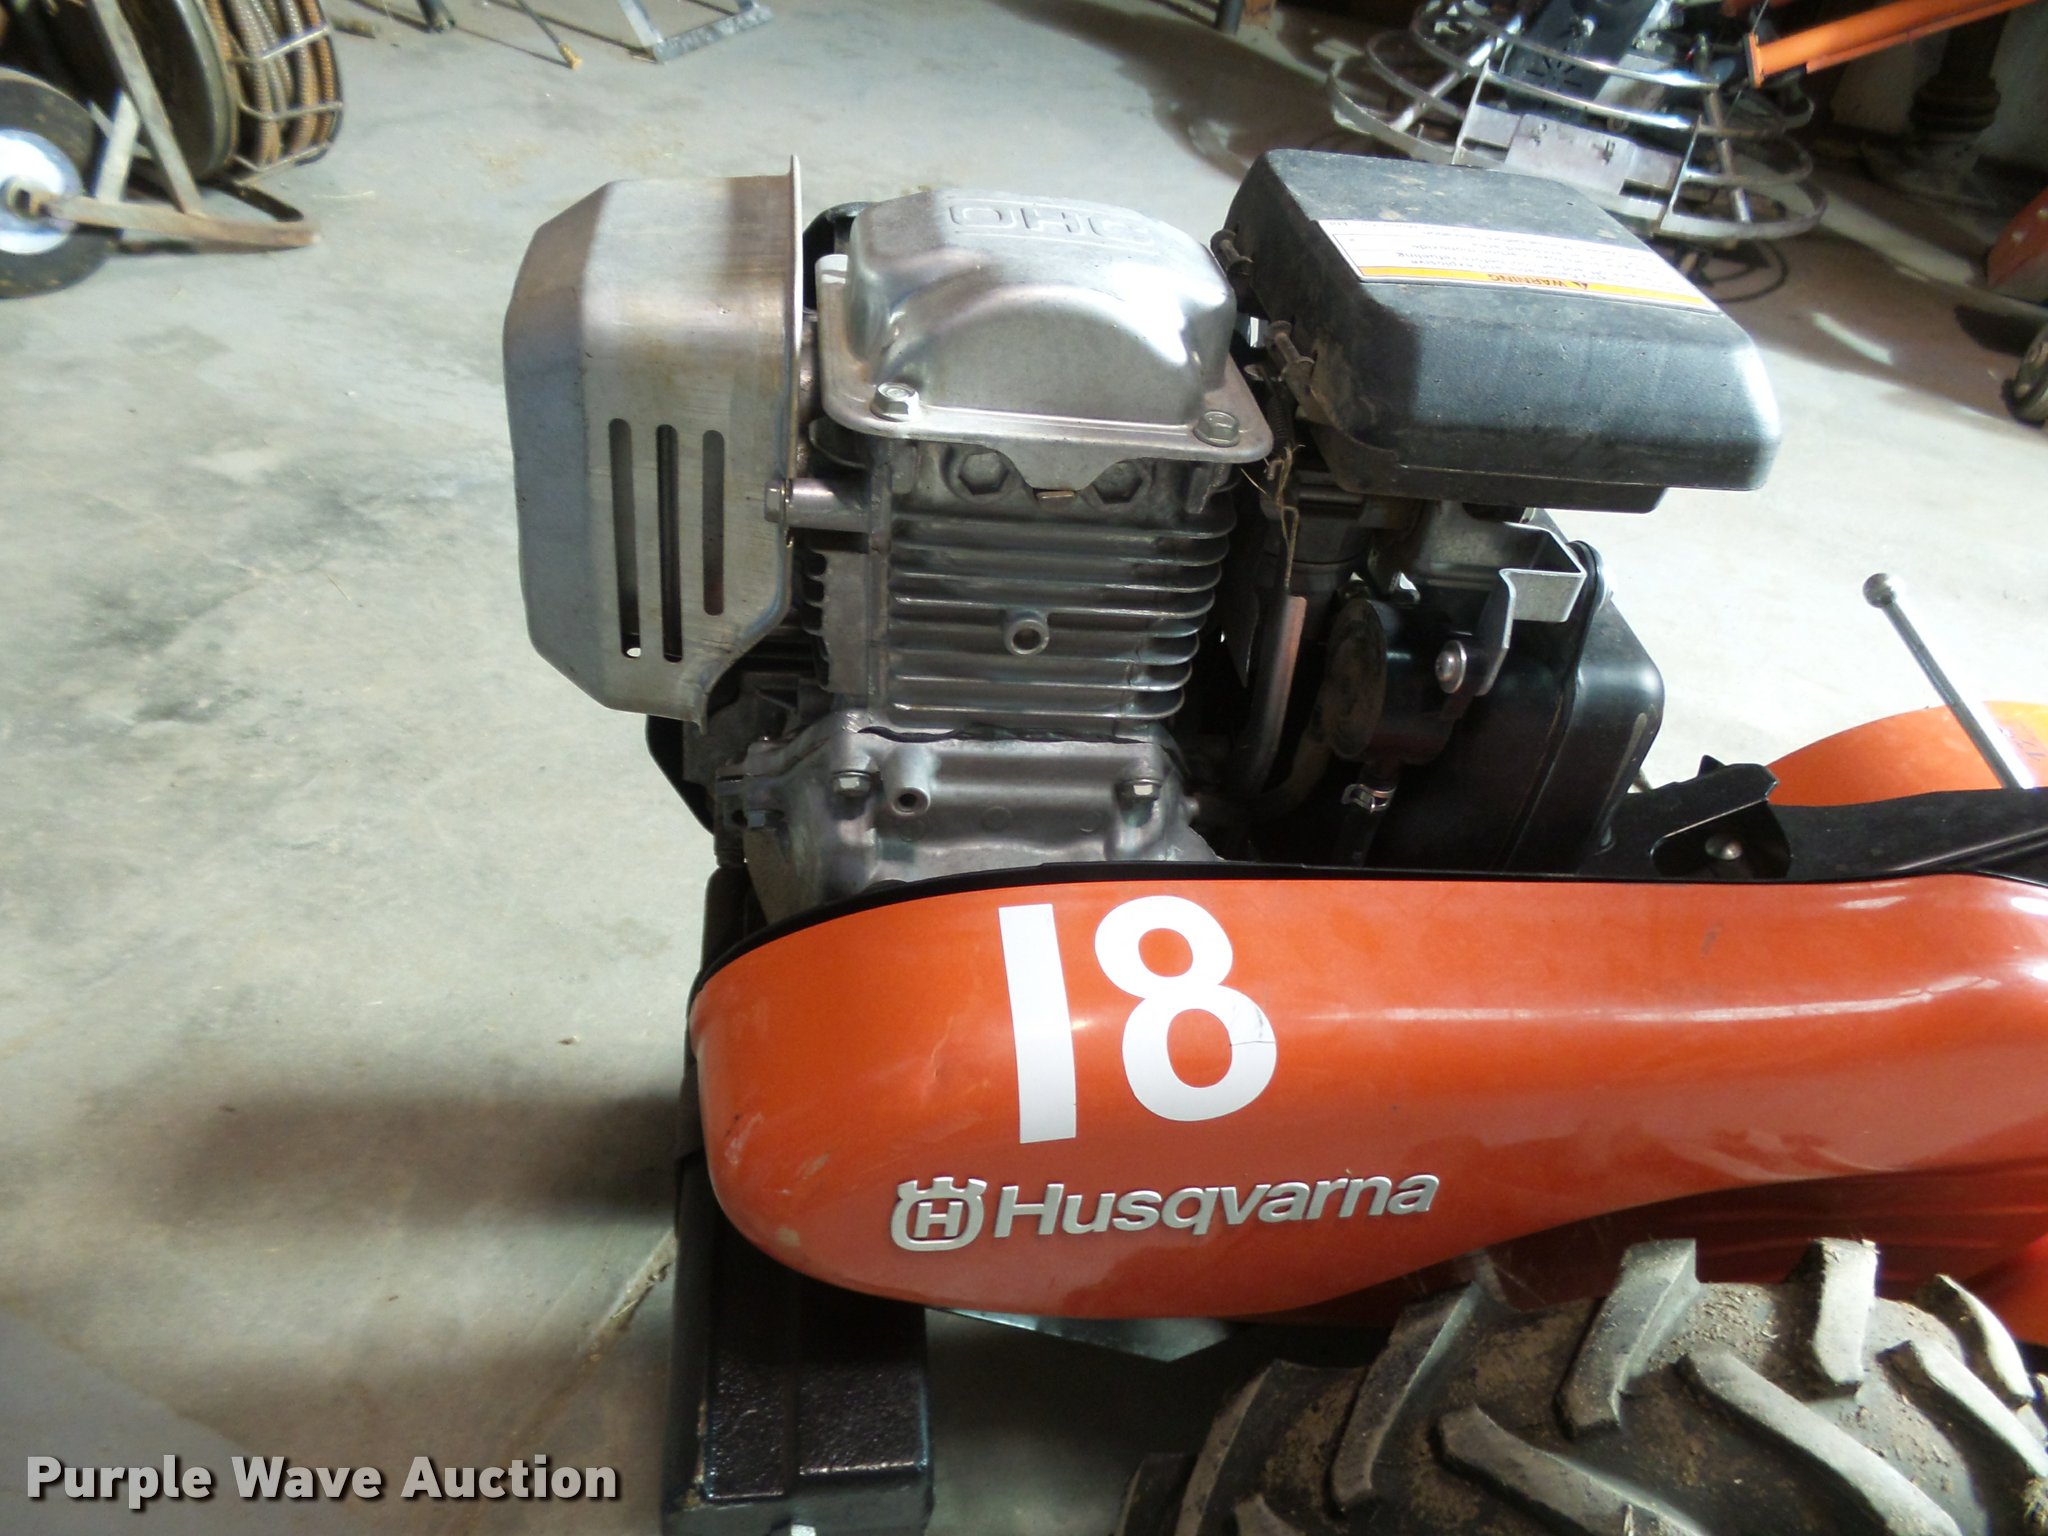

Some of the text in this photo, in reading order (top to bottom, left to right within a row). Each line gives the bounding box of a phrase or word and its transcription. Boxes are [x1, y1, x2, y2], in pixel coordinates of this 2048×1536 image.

[948, 205, 1155, 247] OHC
[1487, 273, 1568, 288] WARNING
[998, 895, 1277, 1144] 18
[993, 1174, 1440, 1238] Husqvarna
